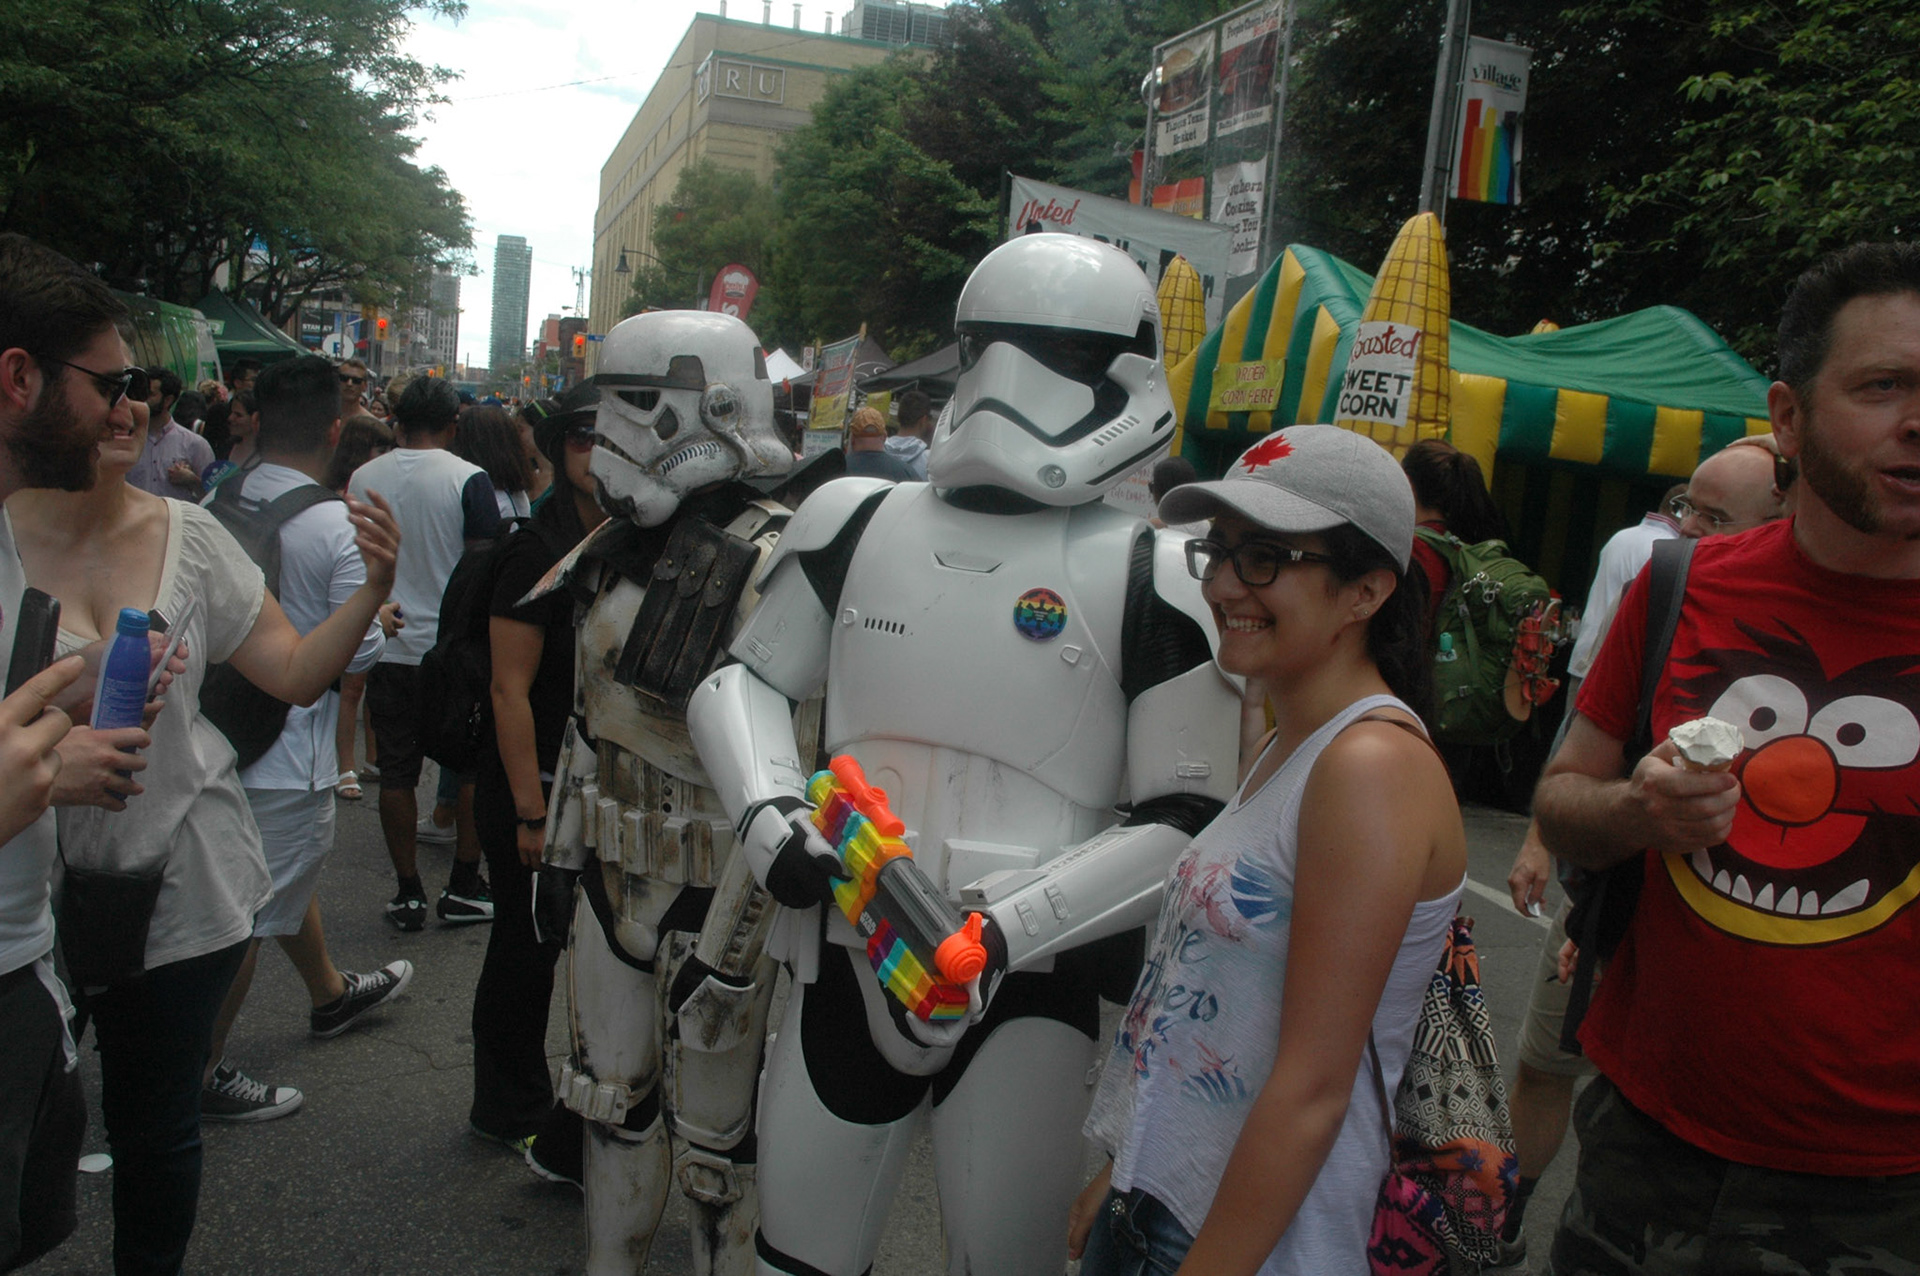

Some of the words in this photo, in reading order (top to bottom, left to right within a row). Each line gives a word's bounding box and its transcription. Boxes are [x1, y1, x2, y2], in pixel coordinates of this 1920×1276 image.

[1226, 178, 1262, 196] Suthern
[302, 323, 333, 332] STANEY
[1222, 390, 1246, 405] CORN
[1248, 388, 1275, 405] HERE
[1340, 392, 1398, 419] CORN
